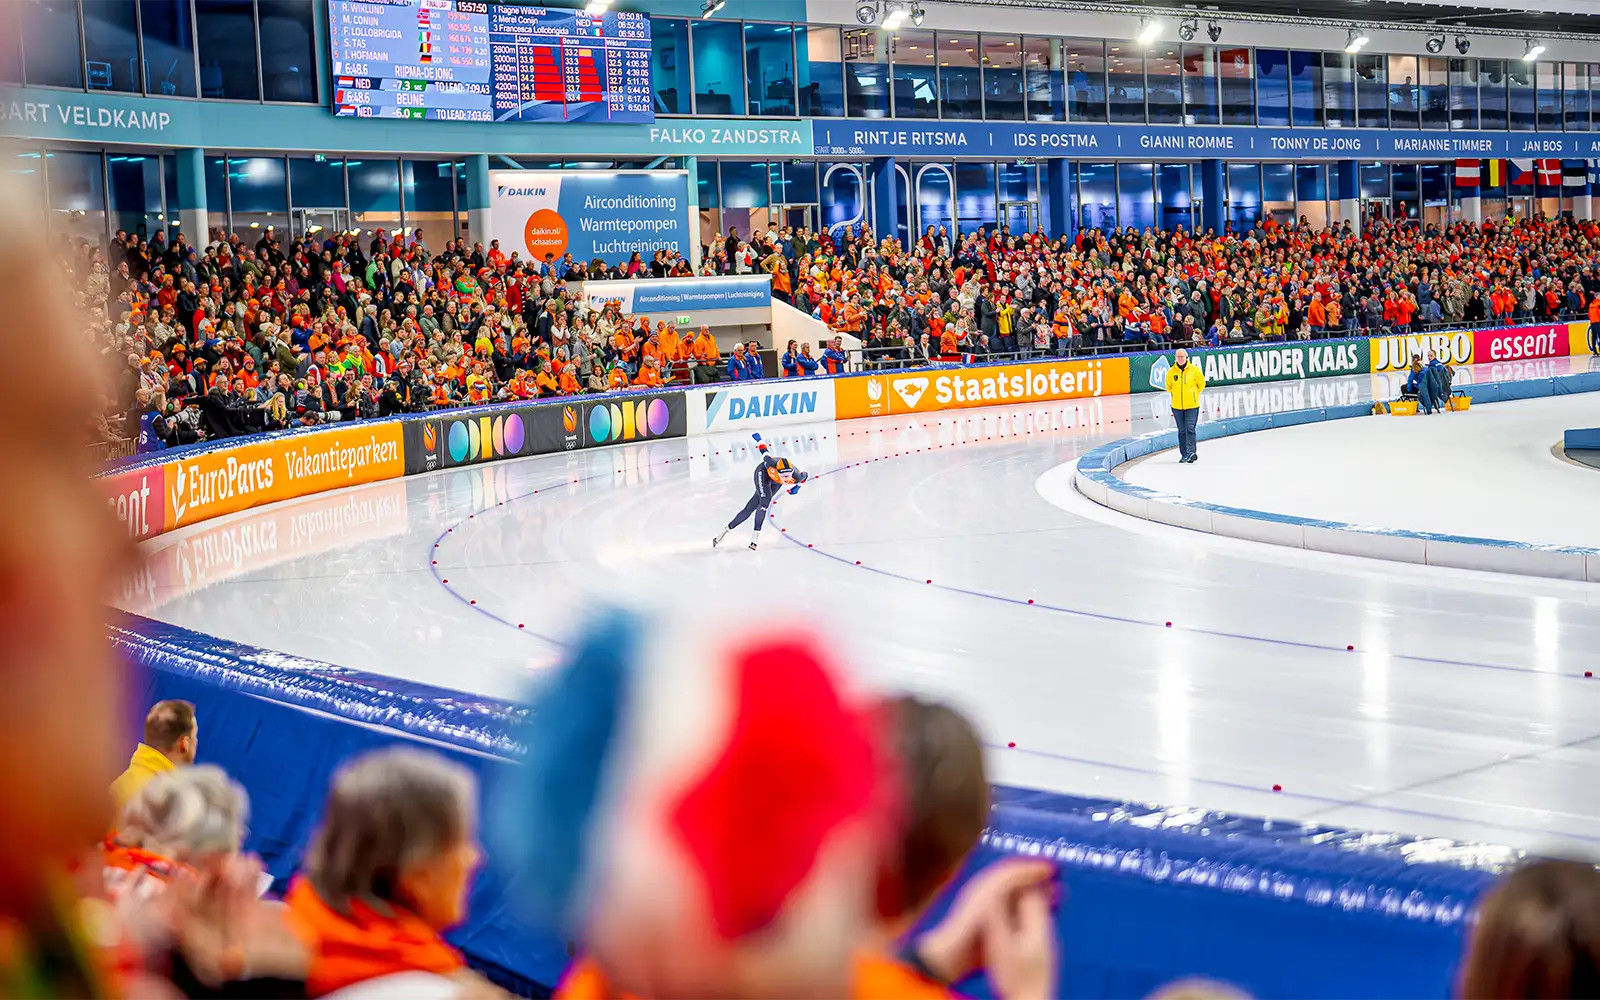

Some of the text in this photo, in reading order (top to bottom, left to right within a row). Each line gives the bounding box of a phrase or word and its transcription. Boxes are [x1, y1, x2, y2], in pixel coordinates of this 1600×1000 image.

[342, 3, 350, 12] R.
[351, 4, 385, 15] WIKLUND
[457, 2, 487, 13] 15:57:50
[520, 7, 546, 15] Wiklund
[617, 12, 643, 20] 06:50.81
[343, 15, 352, 24] M.
[518, 16, 538, 26] Conijn
[576, 19, 591, 27] NED
[618, 21, 644, 30] 06:52.43
[344, 26, 350, 35] F.
[351, 27, 402, 39] LOLLOBRIGIDA
[474, 36, 487, 44] 0.73
[493, 24, 645, 38] 3 Francesca Lollobrigida ITA 06:58.50
[344, 38, 351, 47] S.
[352, 39, 366, 48] TAS
[517, 36, 530, 44] Jong
[351, 50, 388, 61] HOFMANN
[565, 57, 579, 65] 33.3
[345, 63, 368, 75] 6:48.6
[434, 67, 453, 80] JONG
[566, 66, 579, 75] 33.5
[566, 75, 580, 83] 33.5
[355, 78, 371, 89] NED
[392, 80, 410, 90] -7.3
[434, 82, 444, 91] TO
[446, 83, 464, 93] LEAD:
[465, 83, 490, 95] 7:09.43
[567, 85, 580, 93] 33.7
[347, 91, 424, 105] 6:48.6 BEUNE
[566, 93, 581, 102] 33.4
[57, 104, 170, 130] VELDKAMP
[357, 106, 372, 117] NED
[392, 108, 410, 118] -6.0
[436, 109, 446, 119] TO
[447, 110, 465, 120] LEAD:
[466, 111, 491, 121] 7:03.66
[650, 128, 802, 144] FALKO ZANDSTRA
[854, 130, 968, 145] RINTJE RITSMA
[1014, 133, 1098, 147] IDS POSTMA
[1140, 135, 1233, 149] GIANNI ROMME
[1271, 137, 1361, 150] TONNY DE JONG
[1394, 138, 1492, 151] MARIANNE TIMMER
[1522, 140, 1562, 151] JAN BOS
[507, 187, 546, 197] DAIKIN
[584, 194, 676, 211] Airconditioning
[531, 227, 561, 236] daikin.nl/
[579, 217, 677, 233] Warmtepompen
[531, 238, 562, 246] schaatsen
[592, 239, 678, 254] Luchtreiniging
[639, 290, 764, 303] Airconditioning Warmtepompen Luchtreiniging
[1490, 327, 1557, 360] essent
[1376, 333, 1472, 371] JUMBO
[1187, 343, 1358, 378] AANLANDER KAAS
[934, 361, 1104, 402] Staatsloterij
[727, 391, 818, 420] DAIKIN
[285, 436, 398, 480] Vakantieparken
[189, 457, 274, 508] EuroParcs
